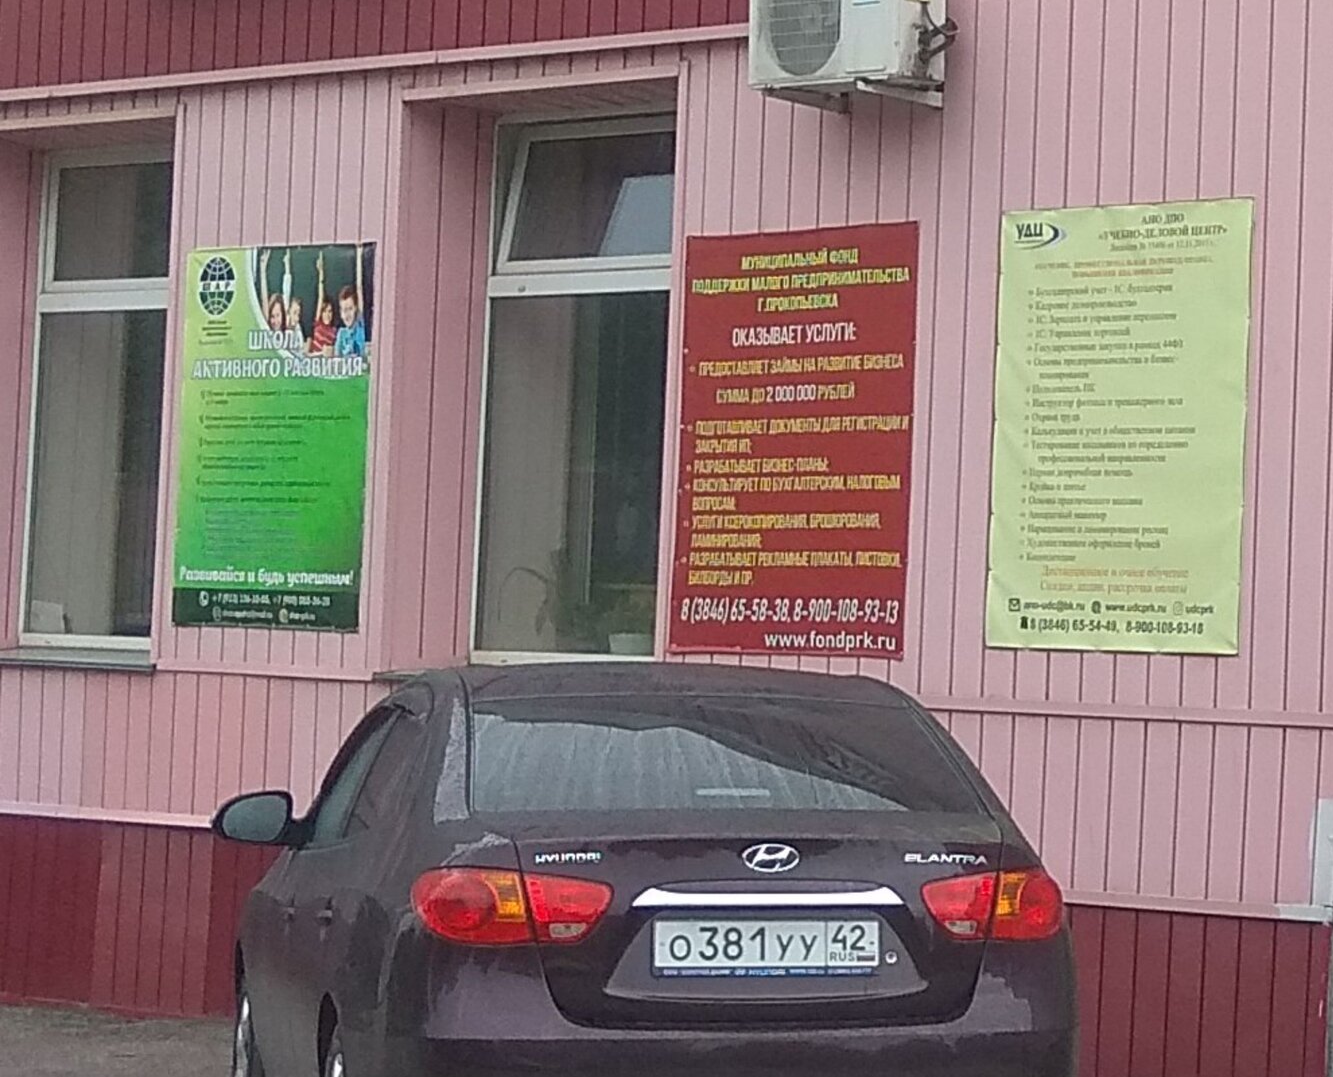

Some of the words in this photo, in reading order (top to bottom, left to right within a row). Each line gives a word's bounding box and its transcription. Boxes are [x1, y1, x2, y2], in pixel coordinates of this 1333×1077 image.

[741, 248, 828, 270] МУНИЦИПАЛЬНЫЙ
[829, 248, 858, 264] ФОНД
[692, 278, 750, 295] ПОДДЕРЖКИ
[751, 274, 789, 292] МАЛОГО
[790, 267, 910, 289] ПРЕДПРИНИМАТЕЛЬСТВА
[248, 330, 304, 350] ШКОЛА
[732, 325, 804, 347] ОКАЗЫВАЕТ
[805, 322, 857, 344] УСЛУГИ:
[193, 359, 281, 378] АКТИВНОГО
[284, 357, 362, 377] РАЗВИТИЯ
[803, 359, 816, 373] НА
[863, 353, 904, 369] БИЗНЕСА
[715, 387, 750, 404] СУММА
[751, 387, 765, 404] ДО
[766, 386, 774, 402] 2
[775, 385, 795, 402] 000
[796, 385, 817, 401] 000
[817, 381, 855, 401] РУБЛЕЙ
[249, 573, 256, 583] и
[258, 568, 284, 587] будь
[681, 597, 689, 620] 8
[690, 597, 729, 624] (3846)
[730, 597, 792, 623] 65-58-38,
[793, 597, 899, 624] 8-900-108-93-13
[765, 630, 896, 652] www.fondprk.ru
[904, 852, 988, 865] ELANTRA
[831, 924, 867, 951] 42
[829, 952, 855, 962] RUS
